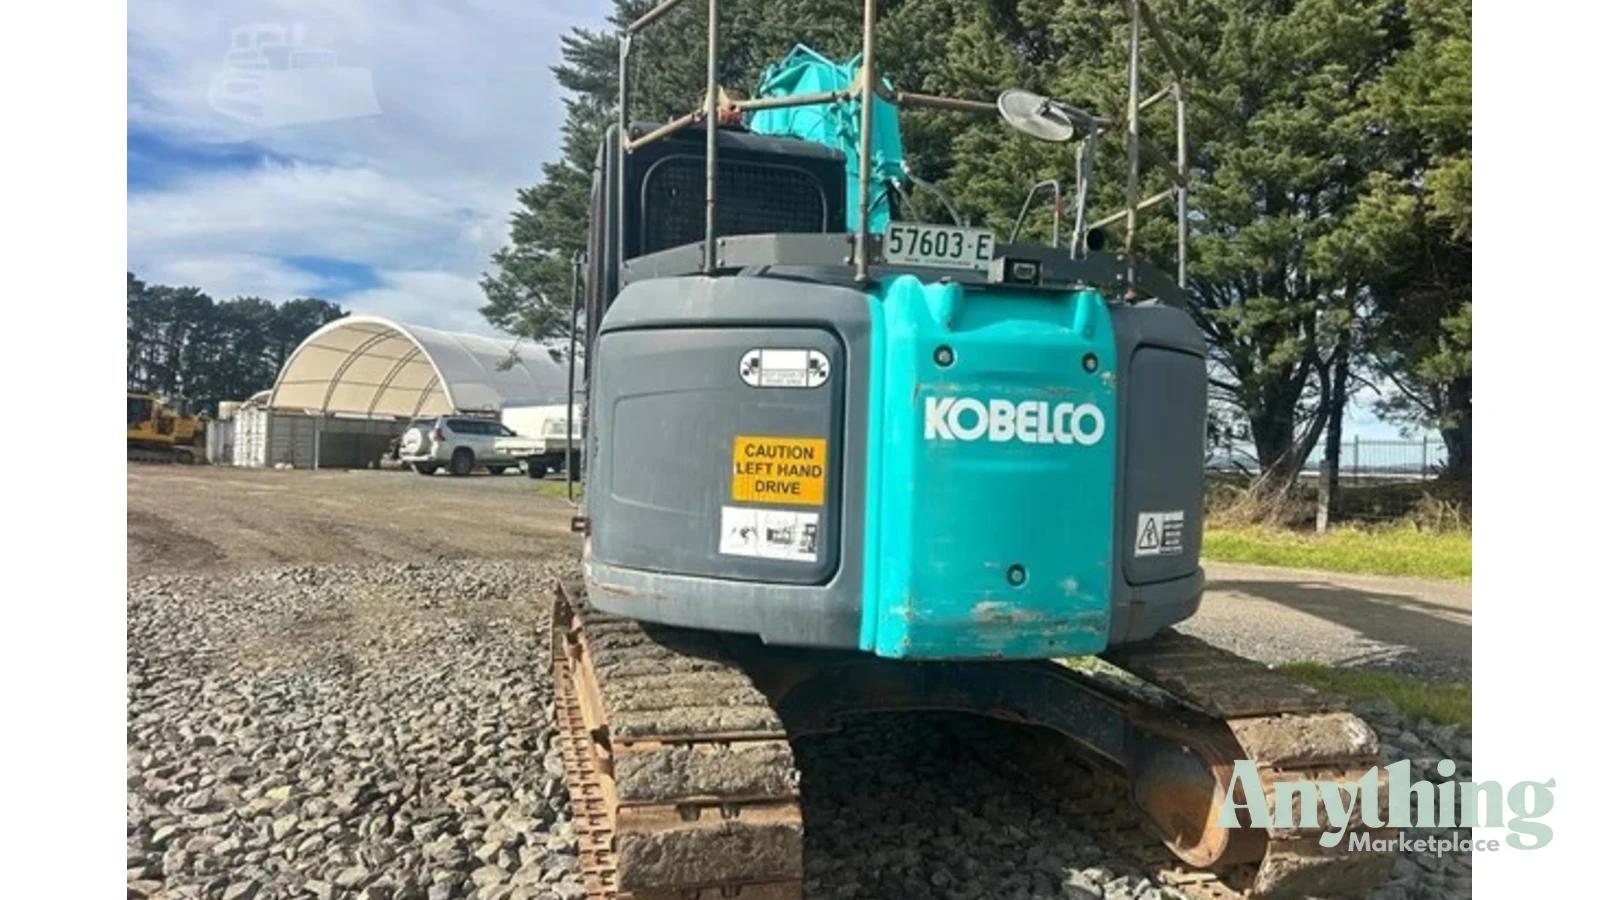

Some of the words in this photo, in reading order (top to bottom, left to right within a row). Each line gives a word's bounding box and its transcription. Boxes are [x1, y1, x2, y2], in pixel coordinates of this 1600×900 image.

[924, 396, 1105, 446] KOBELCO
[744, 443, 814, 460] CAUTION
[736, 462, 774, 476] LEFT
[777, 464, 822, 478] HAND
[755, 480, 801, 494] DRIVE
